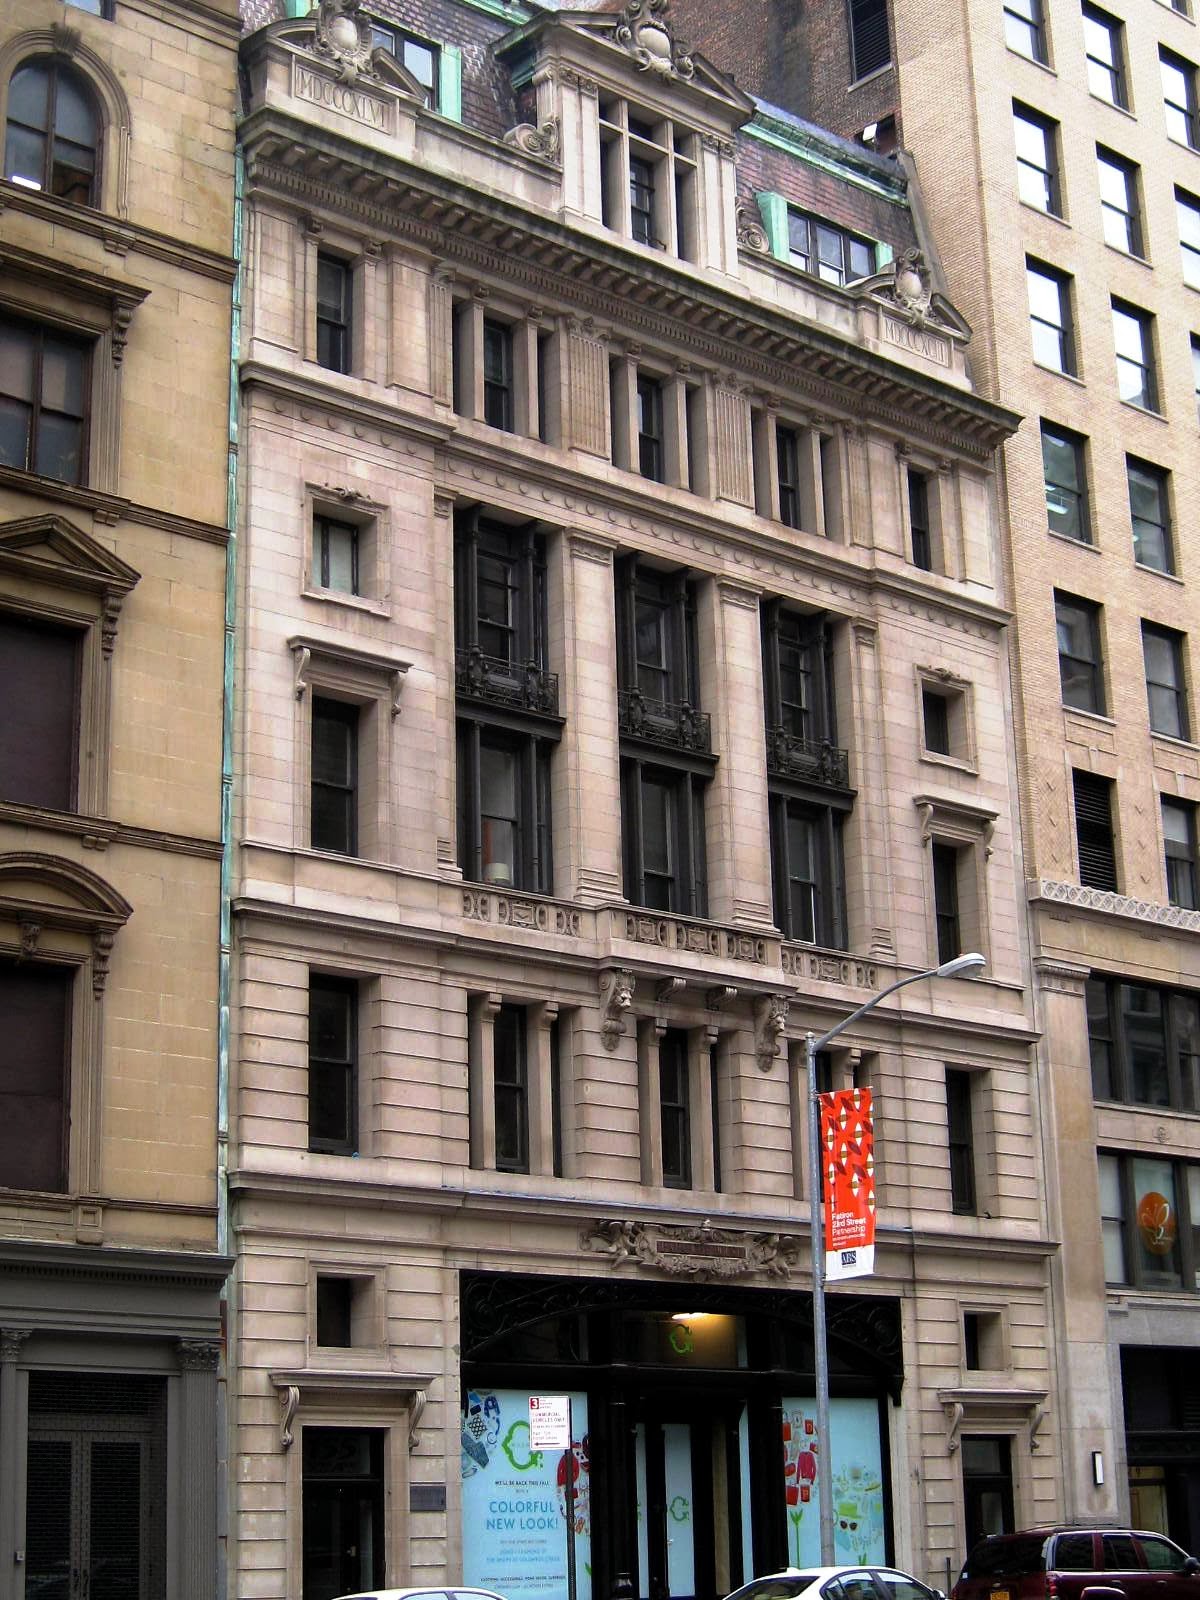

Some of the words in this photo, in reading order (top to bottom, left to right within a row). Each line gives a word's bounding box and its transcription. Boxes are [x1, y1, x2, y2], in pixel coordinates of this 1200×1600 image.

[489, 1501, 556, 1513] COLORFUL
[485, 1518, 515, 1530] NEW
[520, 1517, 559, 1530] LOOK!
